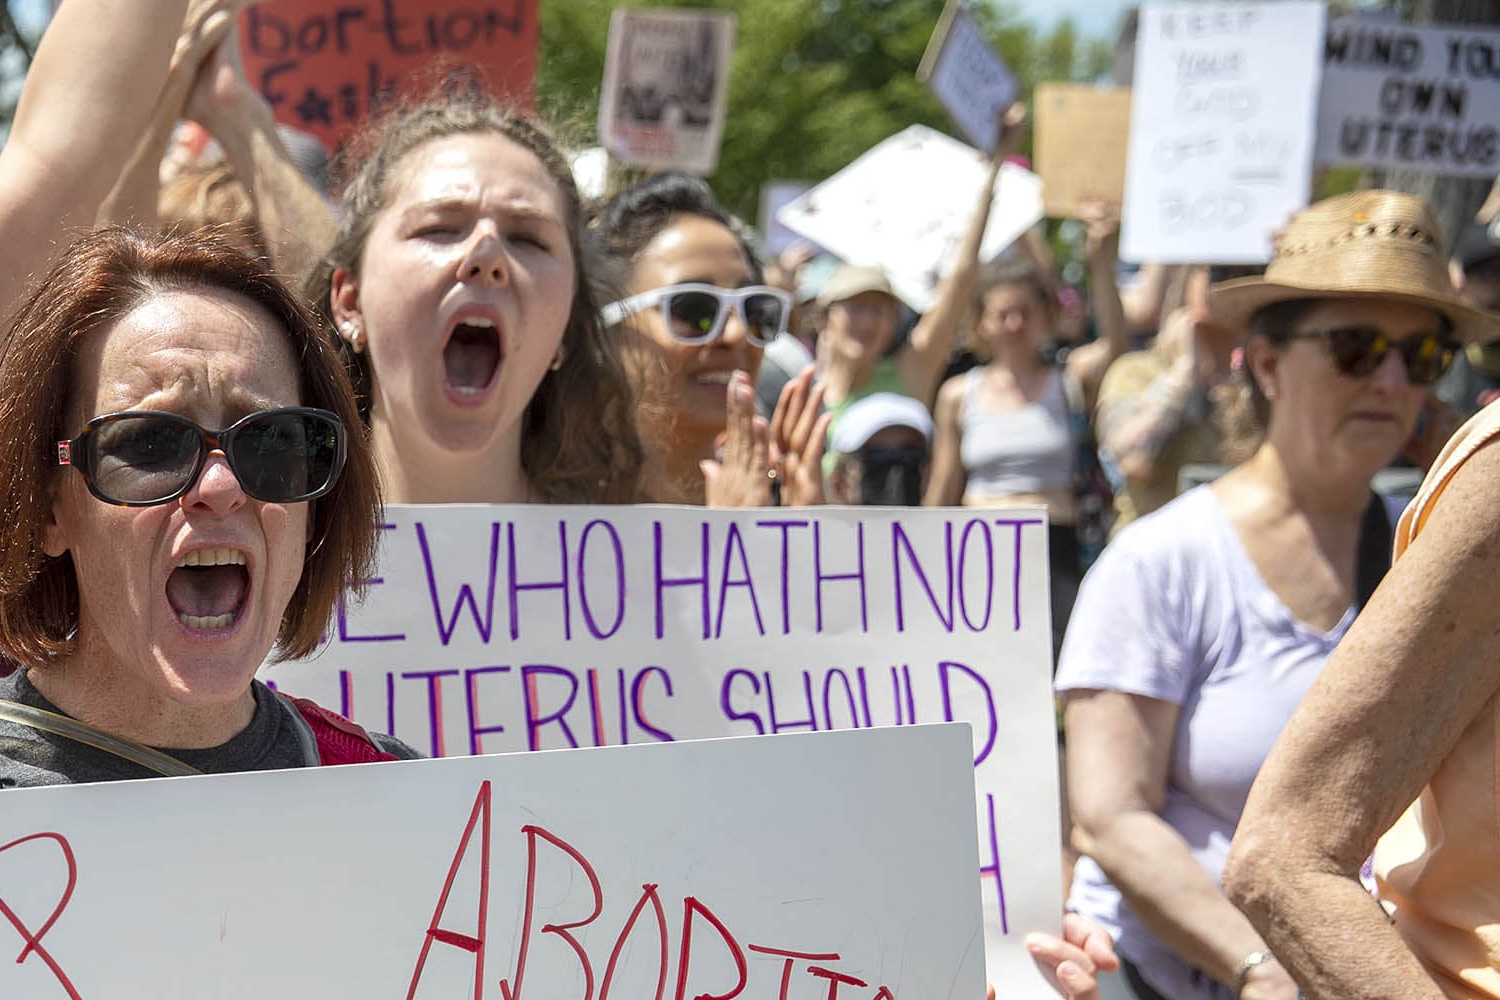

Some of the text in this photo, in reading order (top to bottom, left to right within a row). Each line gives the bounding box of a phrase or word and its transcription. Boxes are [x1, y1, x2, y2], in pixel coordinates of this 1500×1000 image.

[1379, 78, 1468, 117] OWN
[1339, 120, 1498, 166] UTERUS
[414, 518, 627, 646] WHO
[652, 519, 869, 641] HATH
[891, 518, 1044, 633] NOT
